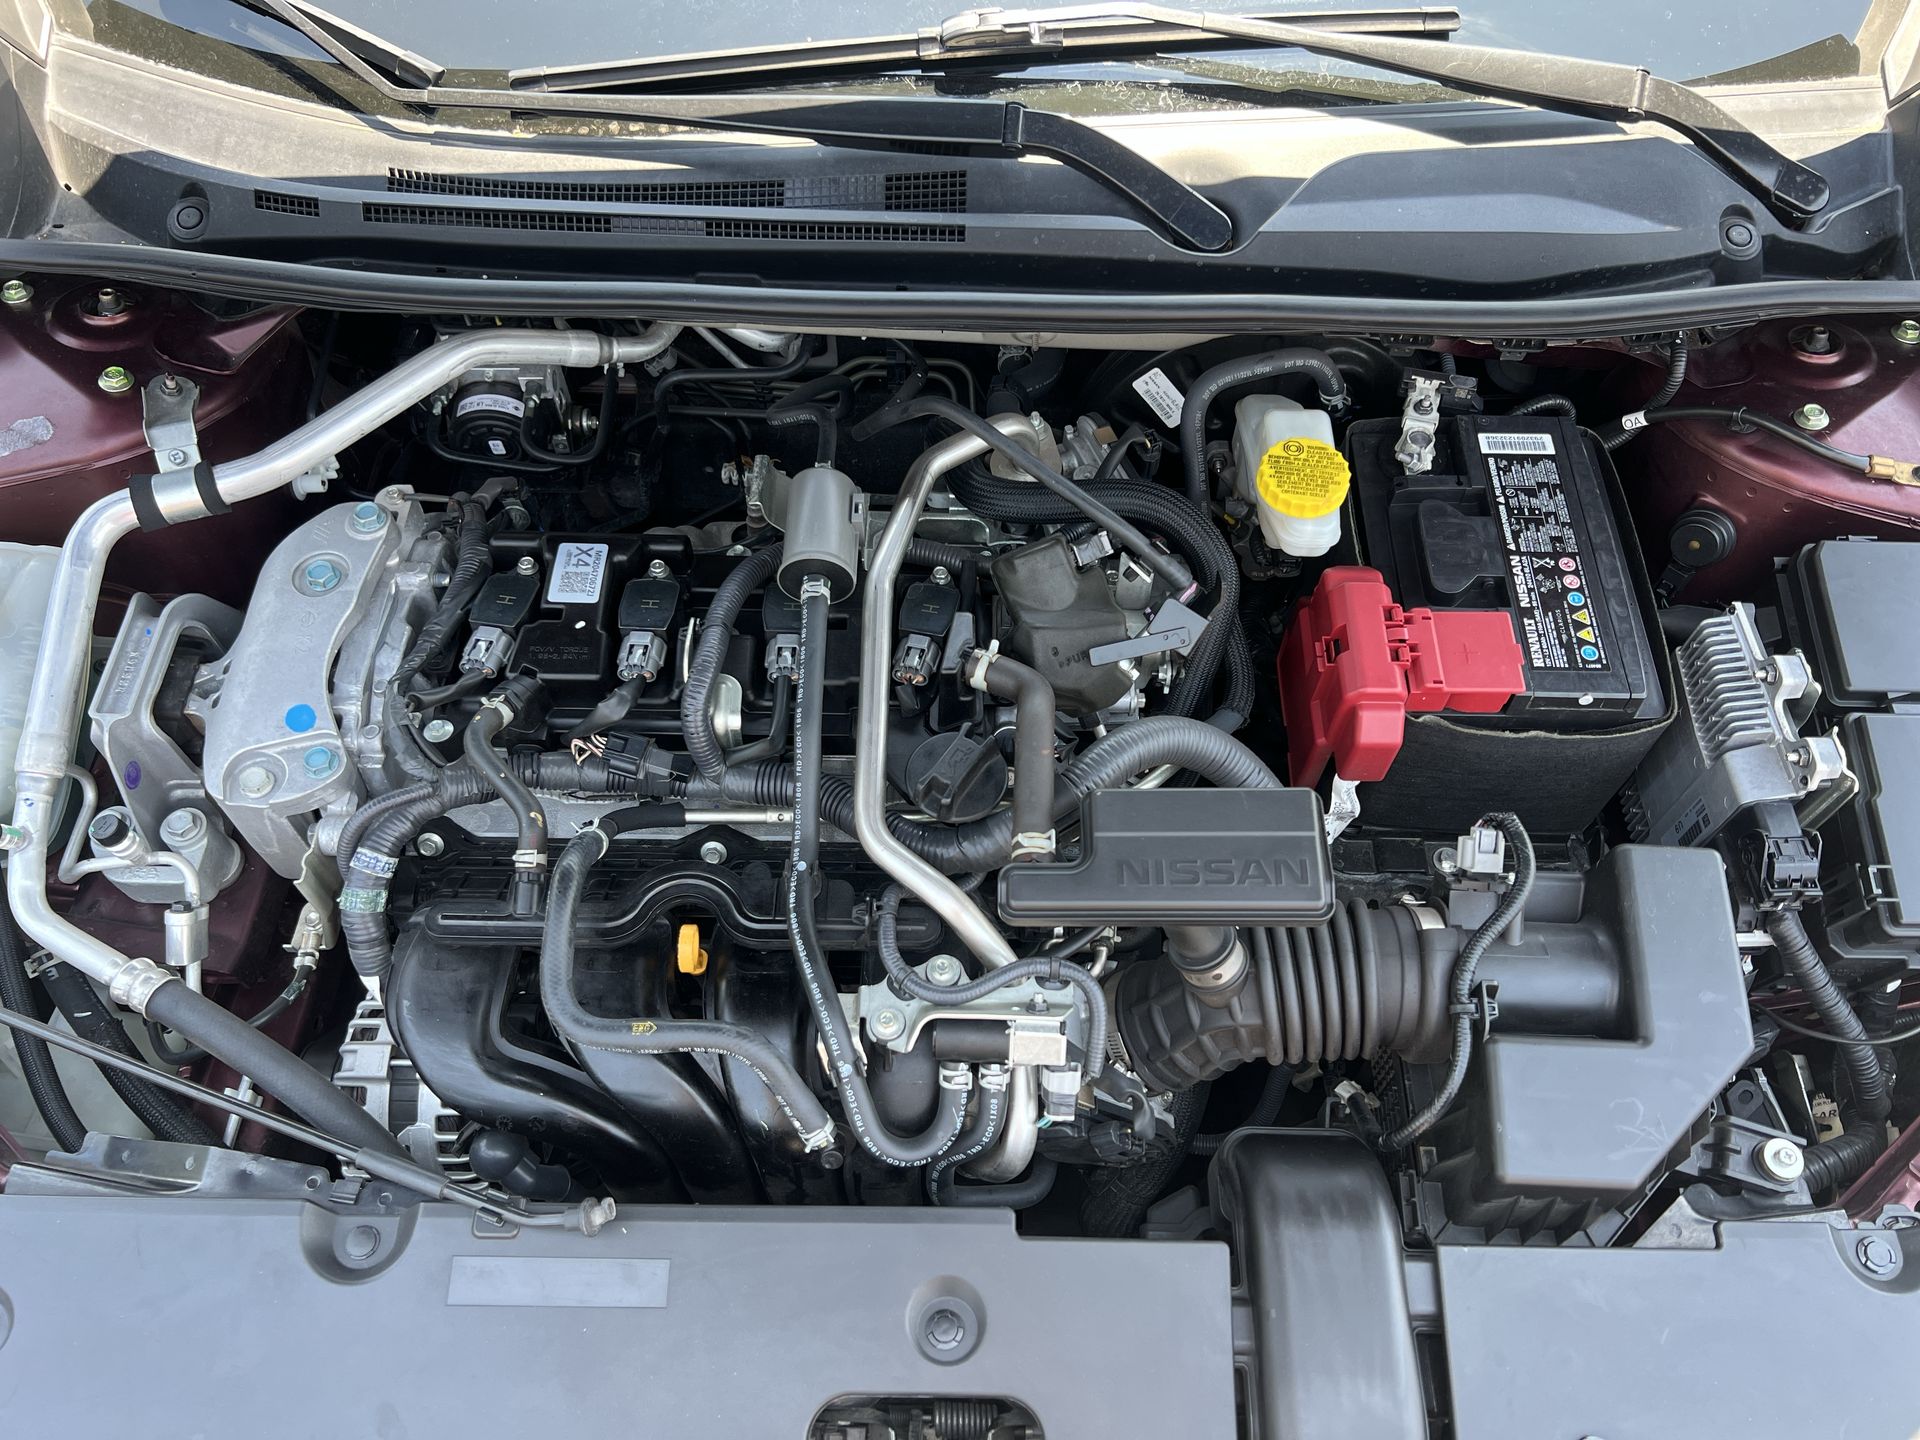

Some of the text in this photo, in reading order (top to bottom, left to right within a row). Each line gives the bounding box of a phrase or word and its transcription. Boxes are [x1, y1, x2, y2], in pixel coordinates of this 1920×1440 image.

[571, 546, 595, 569] X4
[1509, 555, 1545, 667] RENAULT NISSAN
[1554, 609, 1566, 633] CLARIOS
[1117, 857, 1311, 887] NISSAN
